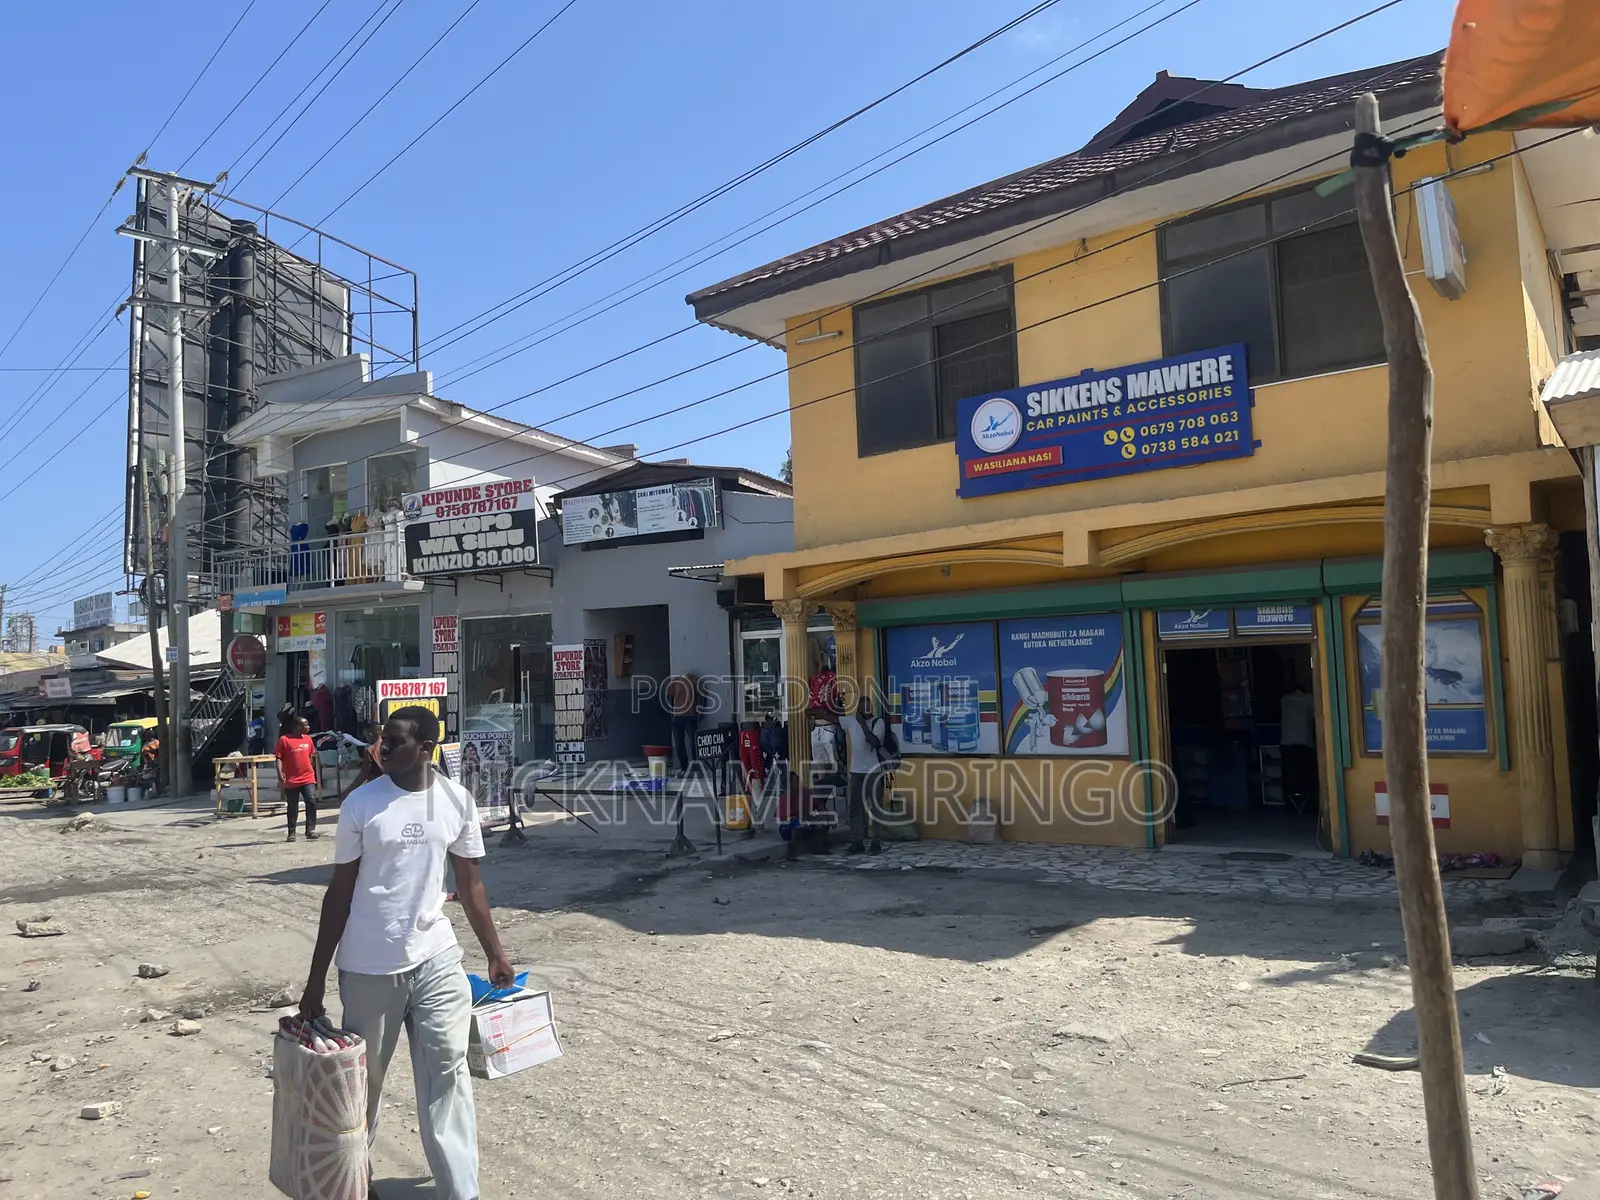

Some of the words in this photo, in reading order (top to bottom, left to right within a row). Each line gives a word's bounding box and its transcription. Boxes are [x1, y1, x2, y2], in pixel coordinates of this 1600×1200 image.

[1026, 377, 1122, 417] SIKKENS
[1127, 354, 1234, 400] MAWERE
[1026, 418, 1054, 432] CAR
[1058, 408, 1109, 426] PAINTS
[1112, 405, 1122, 416] &
[1126, 386, 1232, 414] ACCESSORIES
[1140, 422, 1175, 437] 0679
[1178, 416, 1206, 431] 708
[1210, 411, 1239, 425] 063
[1141, 440, 1176, 455] 0738
[1181, 434, 1209, 449] 584
[1214, 430, 1240, 444] 021
[973, 457, 1027, 472] WASILIANA
[1028, 452, 1052, 463] NASI
[421, 486, 481, 507] KIPUNDE
[485, 479, 533, 498] STORE
[435, 496, 518, 518] 0758787167
[429, 513, 512, 538] MKOPO
[419, 536, 459, 555] WA
[462, 529, 524, 551] SIMU
[412, 552, 474, 574] KIANZIO
[476, 546, 535, 568] 30,000
[434, 629, 455, 642] STORE
[1011, 632, 1030, 640] RANGI
[1031, 630, 1067, 640] MADHUBUTI
[1079, 628, 1105, 637] MAGARI
[1024, 640, 1047, 648] KUTOKA
[1048, 638, 1093, 647] NETHERLANDS
[554, 650, 583, 661] KIPUNDE
[556, 660, 580, 671] STORE
[910, 659, 930, 668] Akzo
[932, 657, 957, 667] Nobel
[381, 683, 426, 697] 0758787
[430, 682, 445, 695] 167
[555, 725, 582, 741] 30,000
[697, 734, 712, 746] CHOO
[713, 733, 724, 744] CHA
